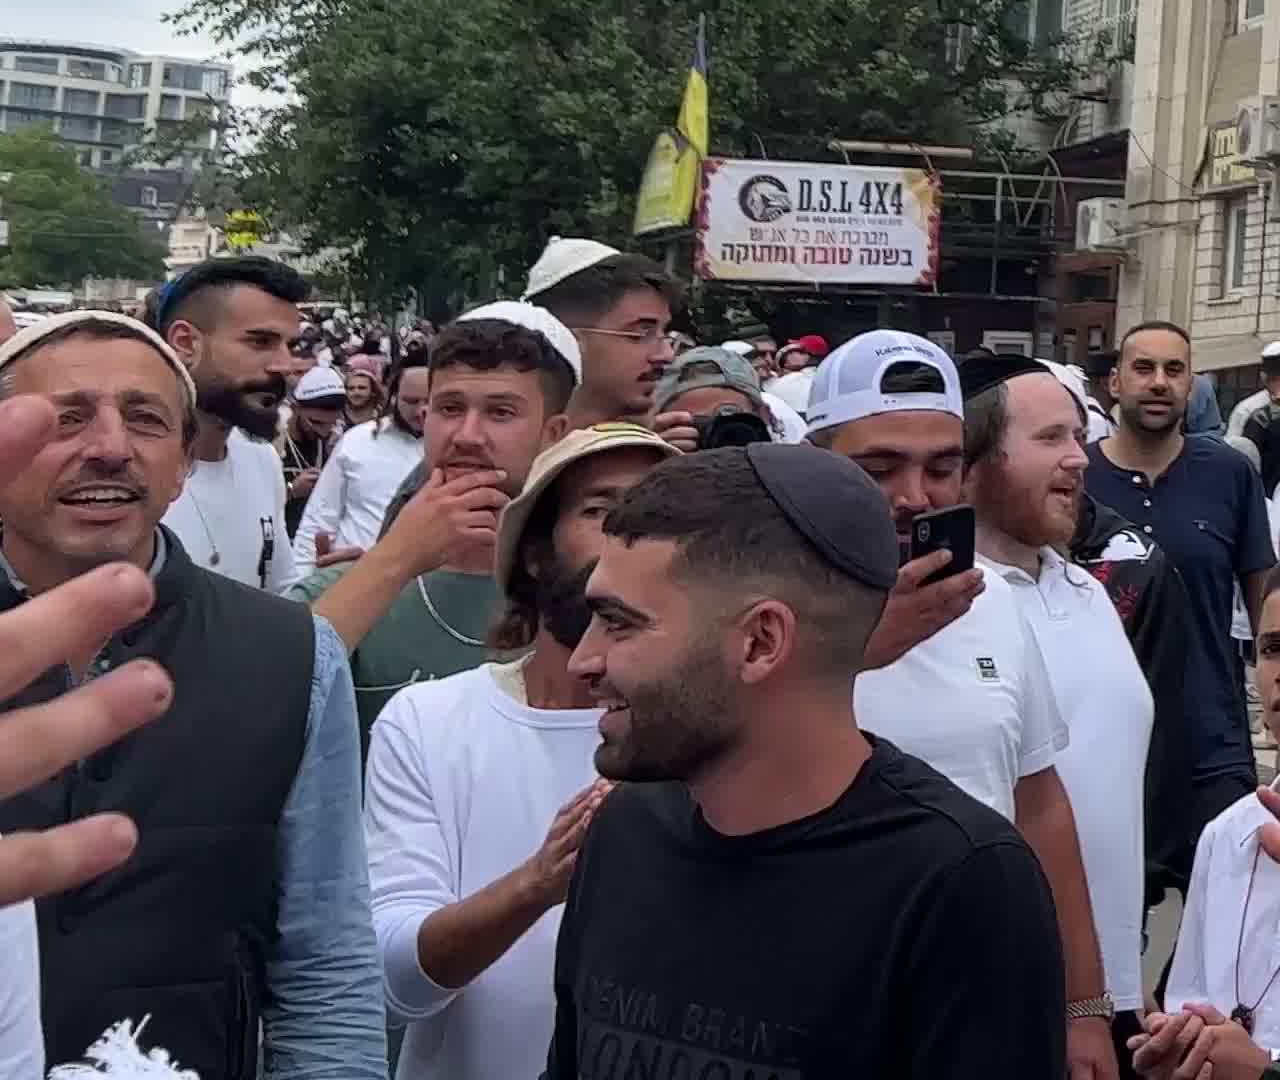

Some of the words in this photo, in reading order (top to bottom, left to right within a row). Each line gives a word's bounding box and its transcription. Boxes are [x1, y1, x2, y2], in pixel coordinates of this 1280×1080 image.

[796, 178, 852, 213] D.S.L
[859, 181, 904, 216] 4X4
[721, 242, 796, 265] ומתוקה
[802, 245, 852, 265] טובה
[859, 247, 913, 266] בשנה
